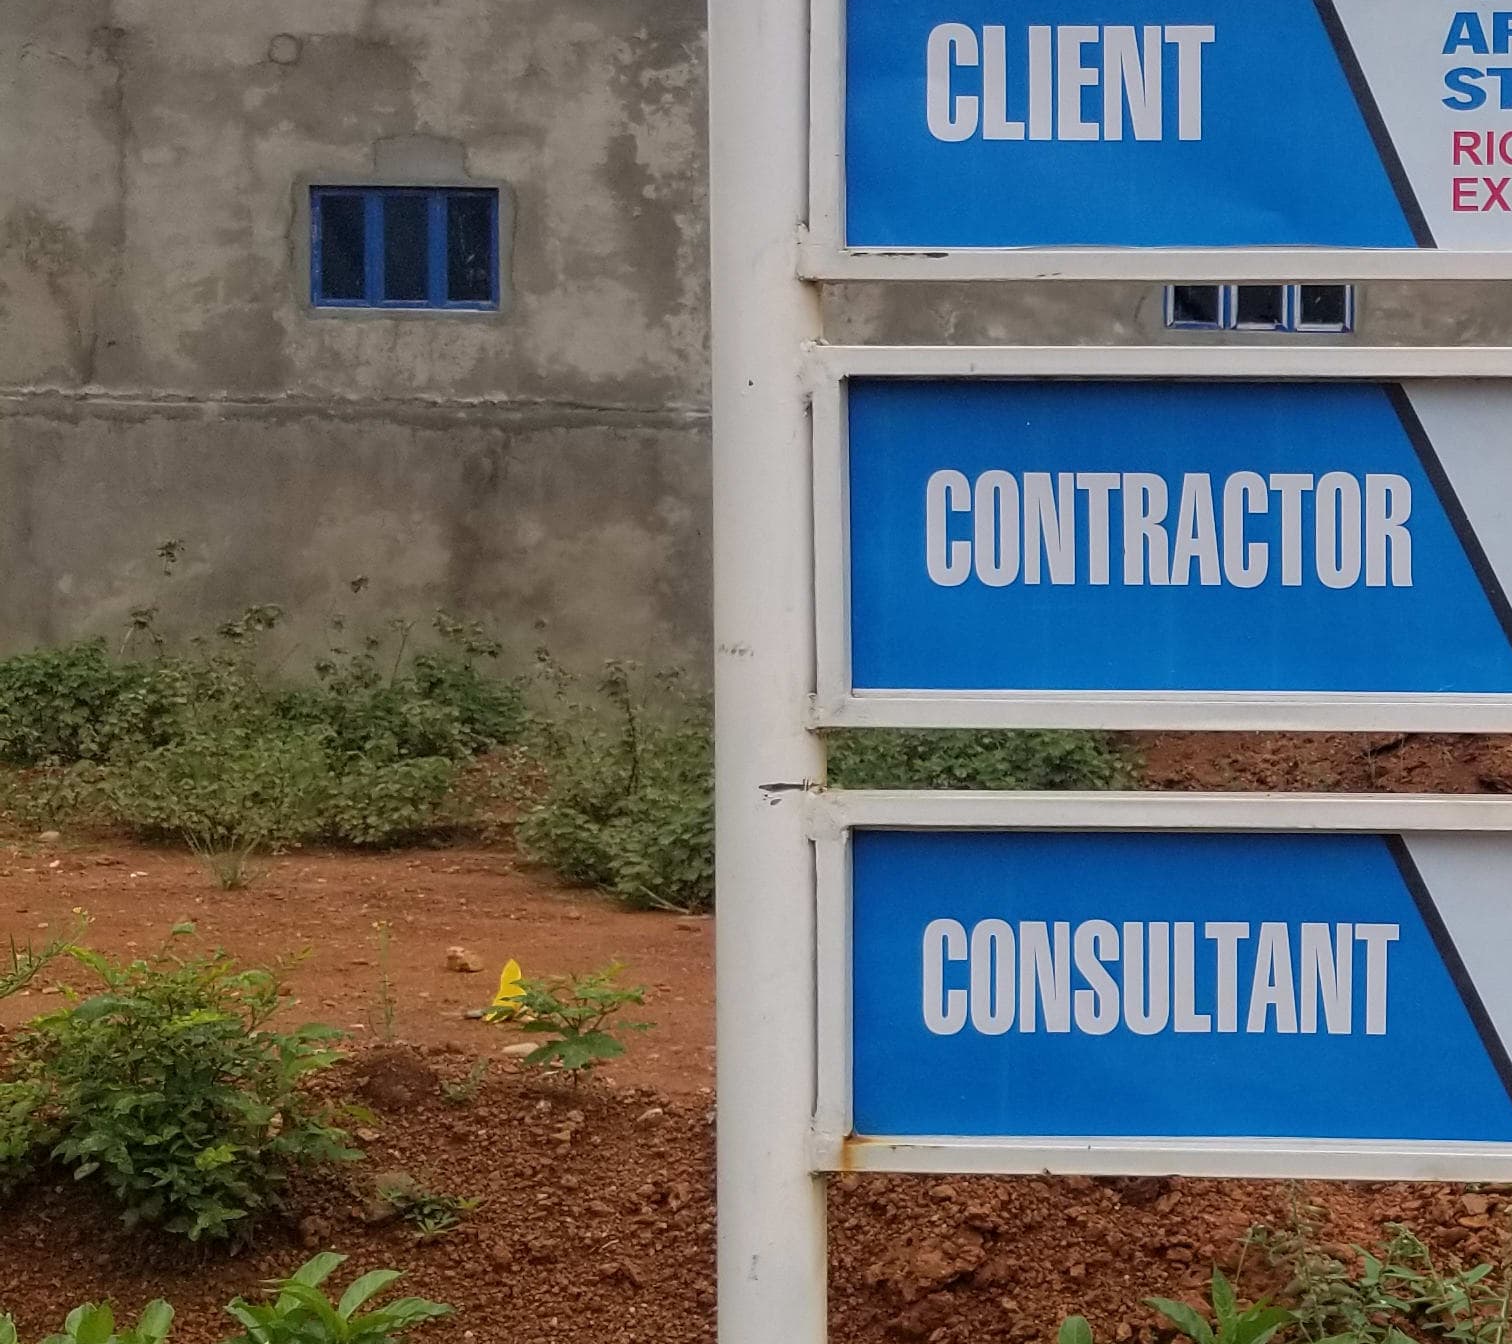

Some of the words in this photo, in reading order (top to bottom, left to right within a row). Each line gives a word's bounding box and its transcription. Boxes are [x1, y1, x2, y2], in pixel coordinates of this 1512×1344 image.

[927, 23, 1215, 141] CLIENT
[926, 470, 1412, 588] CONTRACTOR
[923, 919, 1399, 1035] CONSULTANT
